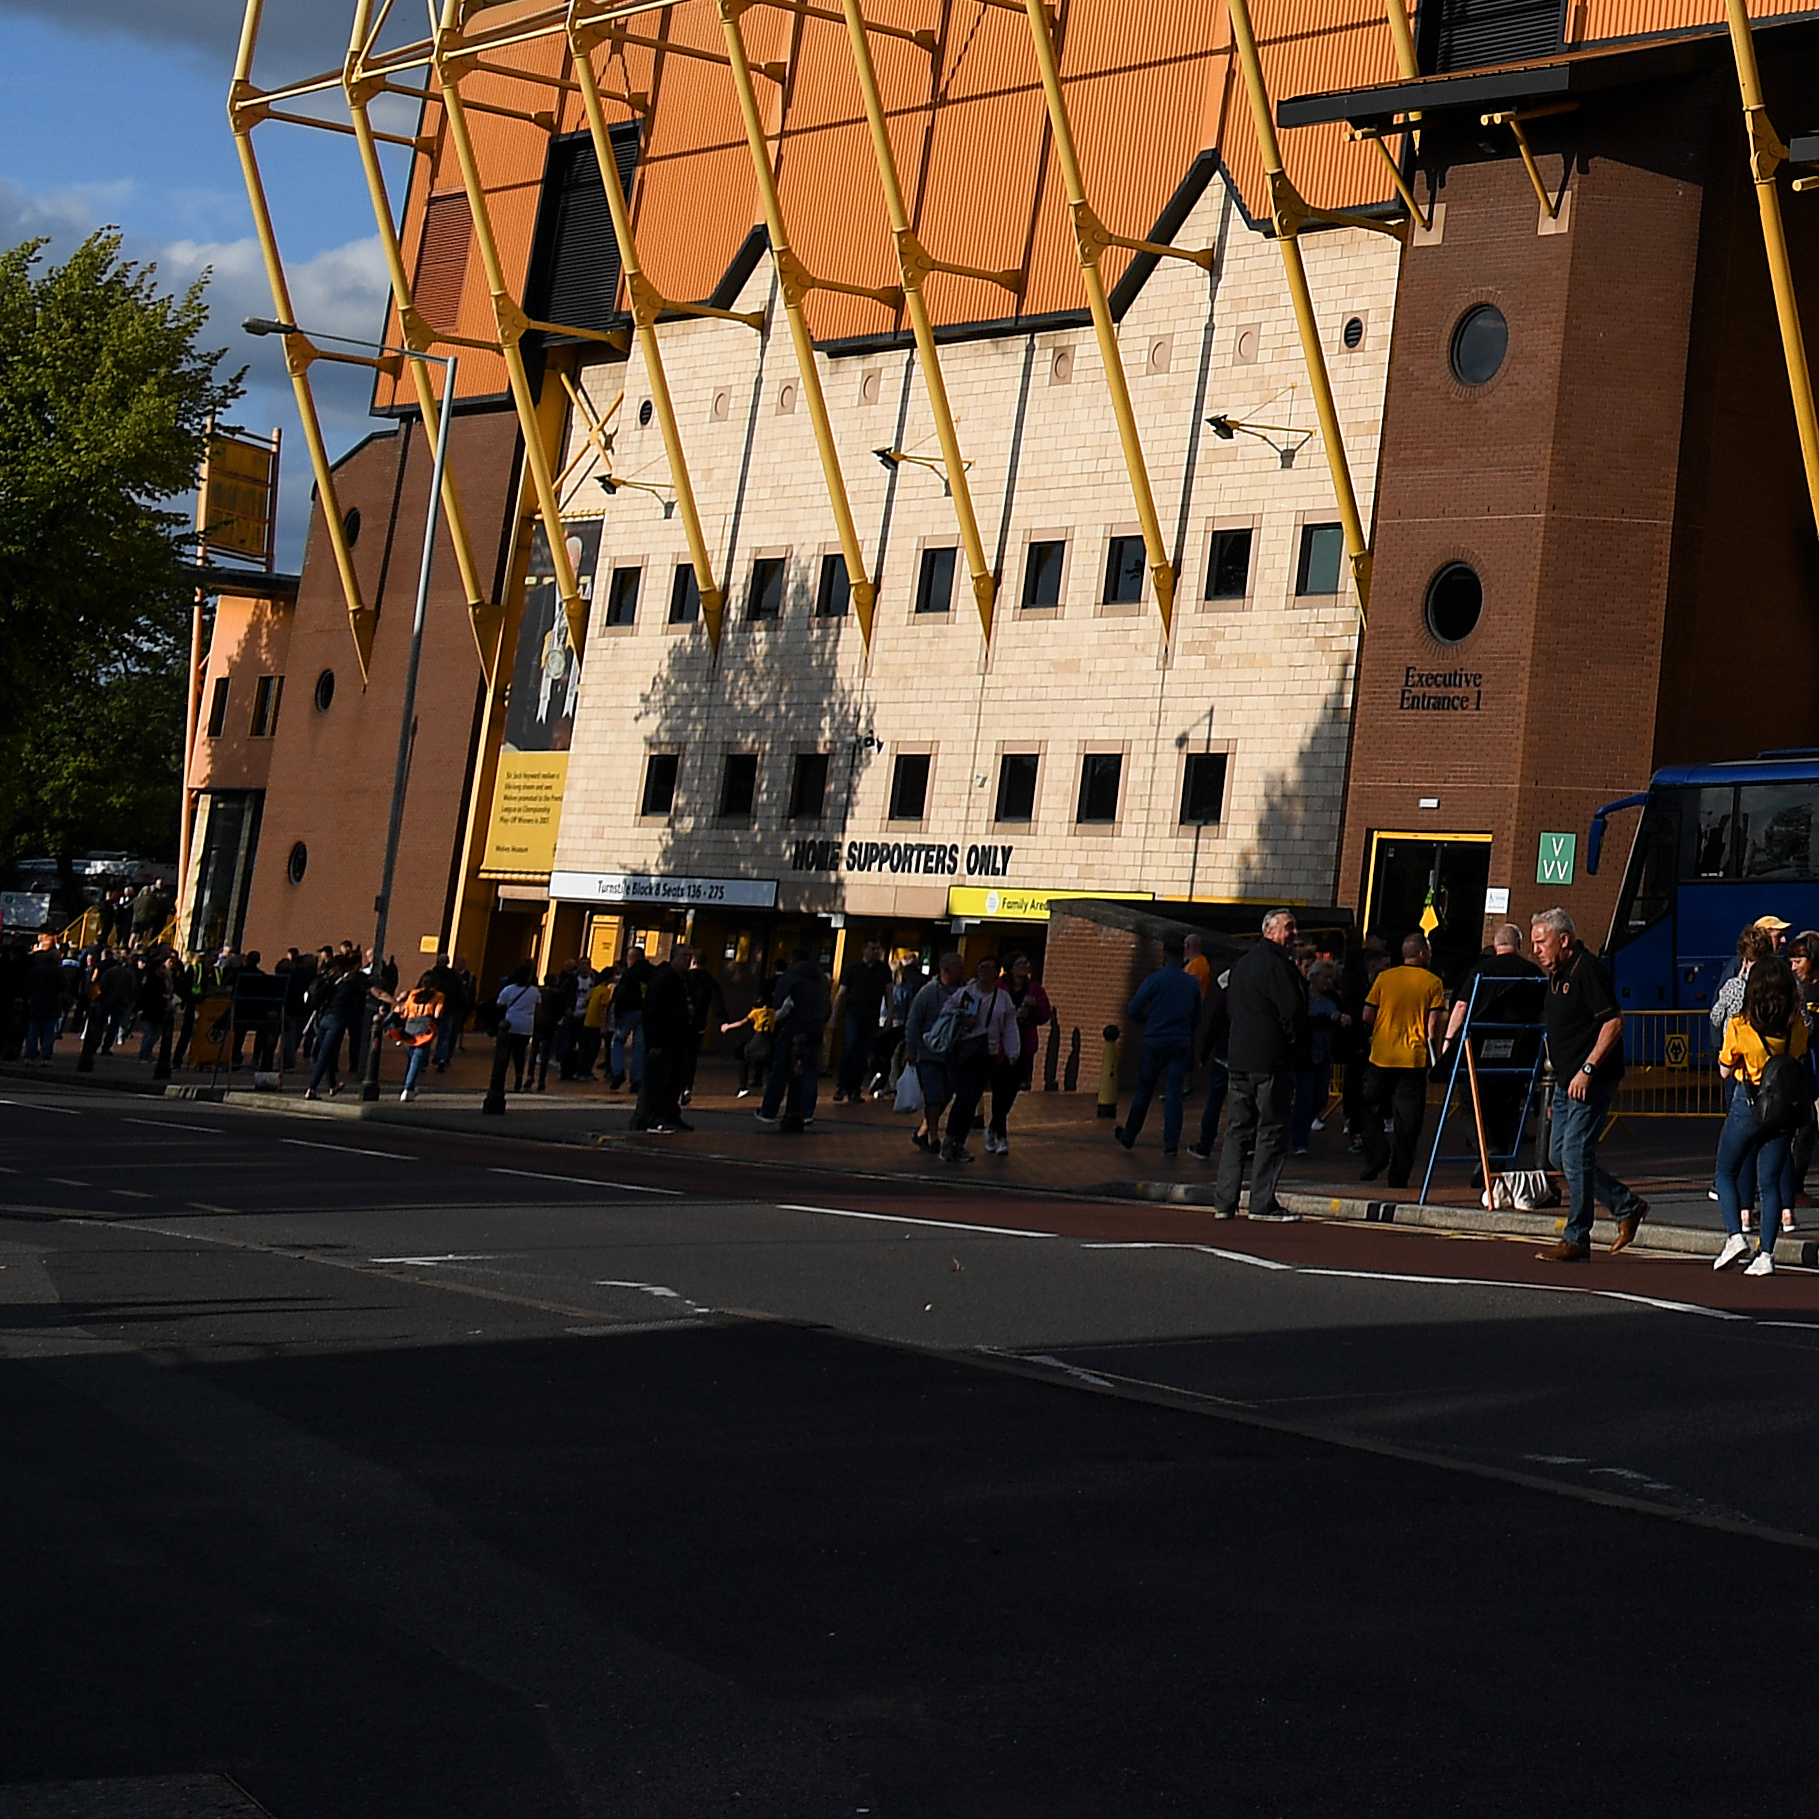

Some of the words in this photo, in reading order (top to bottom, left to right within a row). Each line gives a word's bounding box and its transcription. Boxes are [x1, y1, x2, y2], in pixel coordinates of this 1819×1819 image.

[1404, 666, 1483, 688] Executive
[1399, 688, 1470, 711] Entrance
[1475, 689, 1482, 711] 1
[792, 840, 841, 872] HOME
[846, 841, 959, 875] SUPPORTERS
[966, 845, 1013, 876] ONLY
[632, 881, 652, 897] Block
[662, 883, 684, 899] Seats
[708, 885, 724, 900] 275
[1002, 897, 1028, 913] Family
